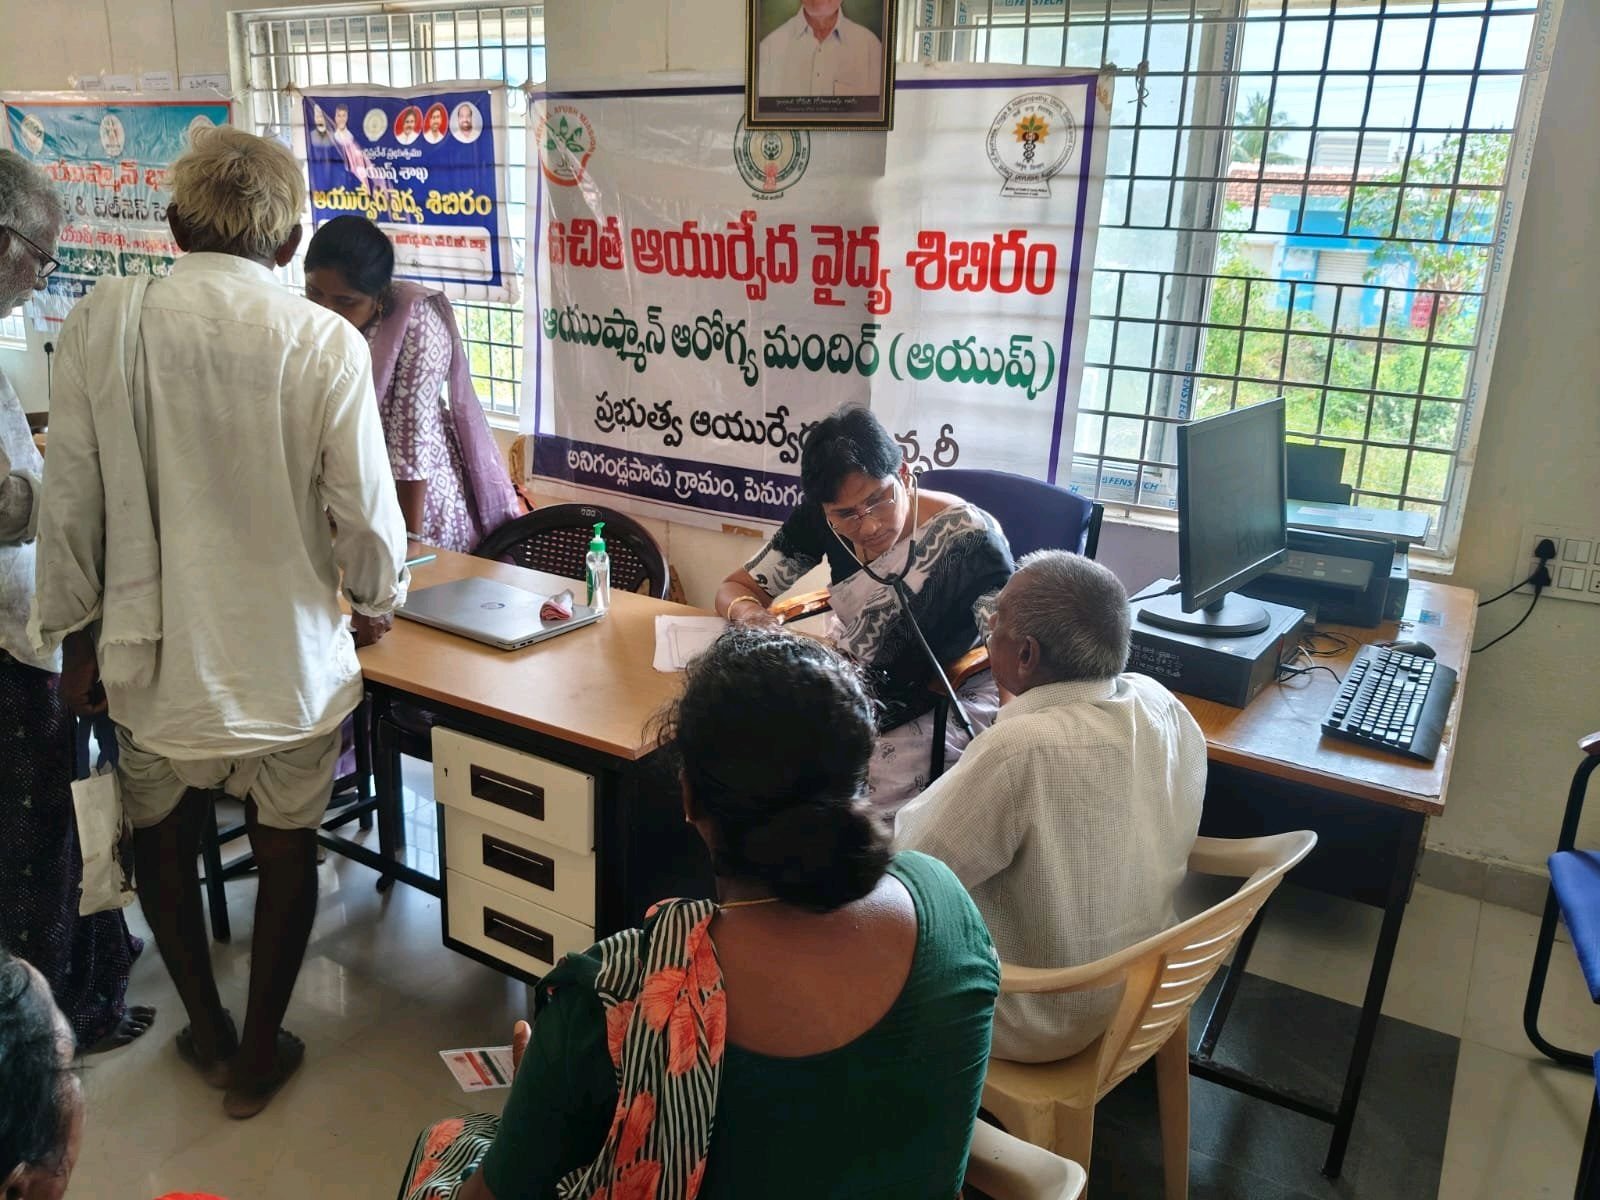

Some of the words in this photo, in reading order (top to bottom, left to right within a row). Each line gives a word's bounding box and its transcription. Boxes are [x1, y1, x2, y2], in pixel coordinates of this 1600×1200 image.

[425, 188, 492, 216] శిబిరం
[630, 209, 799, 302] ఆయుర్వేద
[810, 224, 892, 316] వైద్య
[906, 229, 1057, 296] శిబిరం
[542, 303, 666, 374] ఆయుష్మాన్
[671, 308, 760, 388] ఆరోగ్య
[763, 322, 882, 378] మందిర్
[594, 391, 684, 448] ప్రభుత్వ
[567, 449, 672, 488] అనిగండ్లపాడు
[673, 469, 739, 502] గ్రామం,
